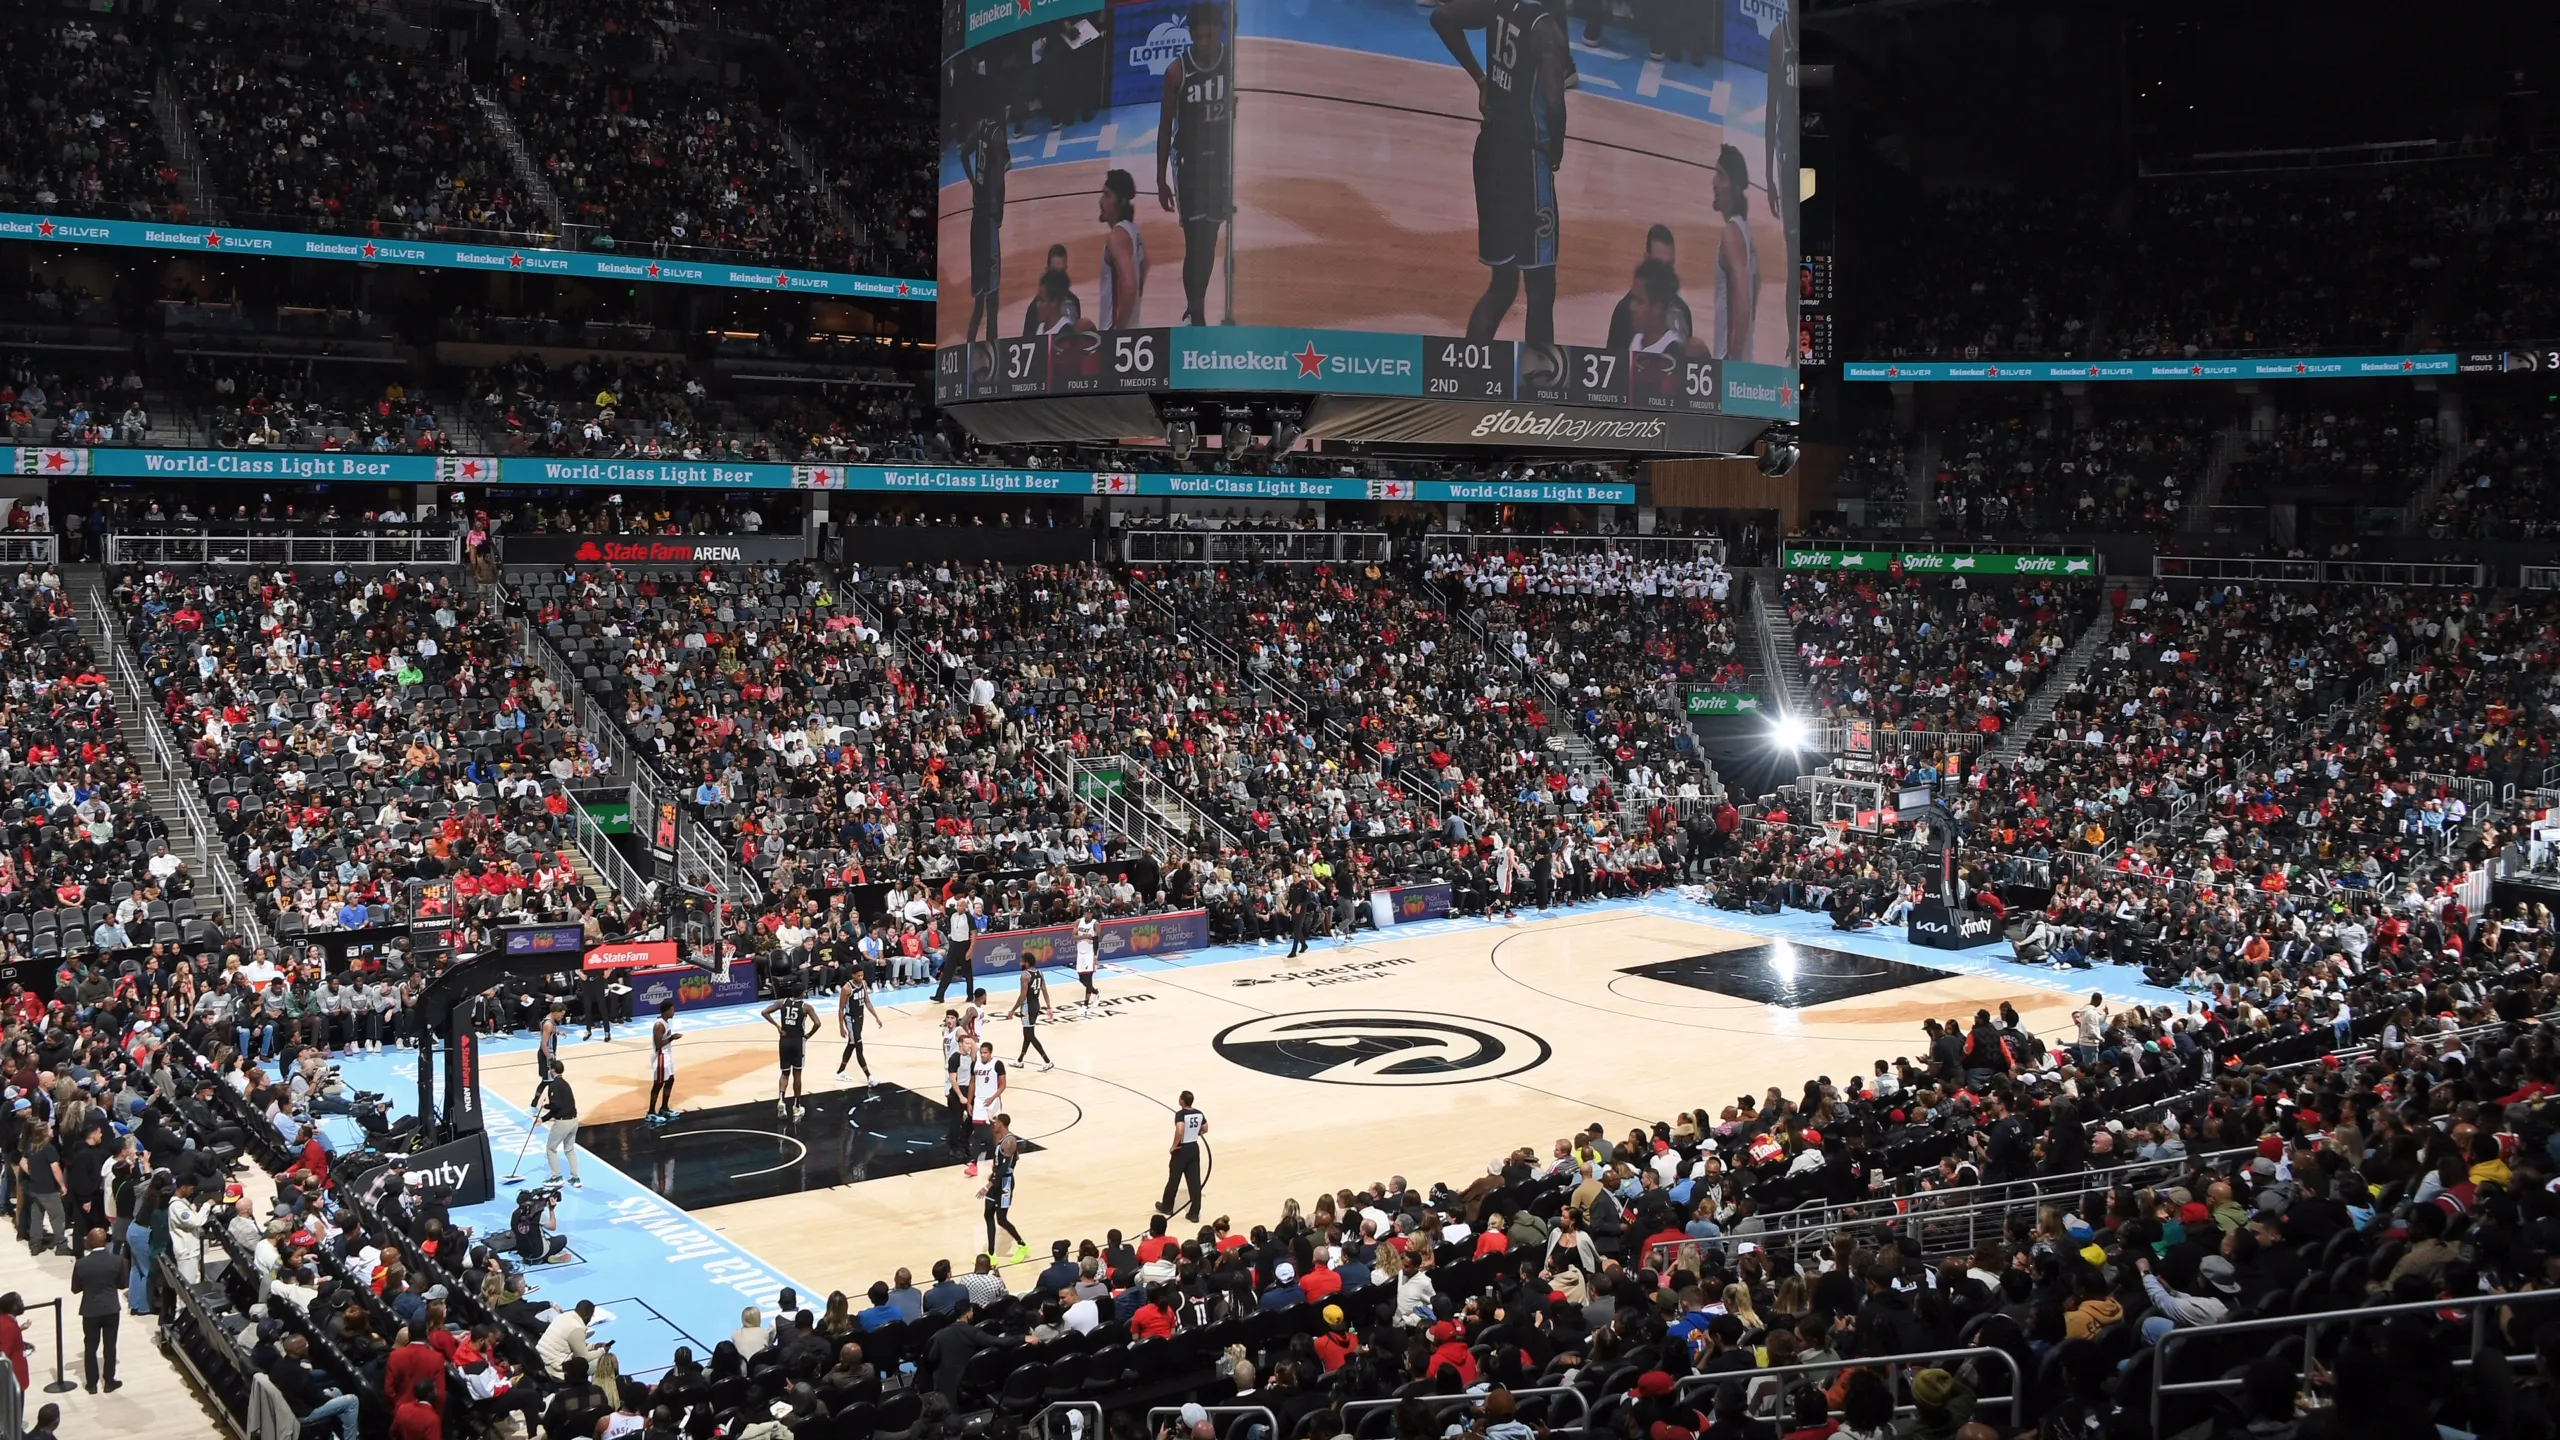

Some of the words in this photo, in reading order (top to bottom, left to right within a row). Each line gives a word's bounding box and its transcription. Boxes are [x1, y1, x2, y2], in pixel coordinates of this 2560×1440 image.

[969, 3, 1012, 31] Heineken
[1743, 0, 1785, 22] LOTTE
[1492, 14, 1520, 70] 15
[1133, 44, 1192, 63] LOTTE
[1187, 75, 1225, 103] atl
[1204, 103, 1226, 122] 12
[58, 226, 110, 239] SILVER
[145, 231, 200, 244] Heineken
[225, 237, 273, 249] SILVER
[306, 242, 357, 255] Heineken
[380, 248, 425, 260] SILVER
[456, 252, 505, 265] Heineken
[526, 258, 568, 269] SILVER
[597, 262, 643, 275] Heineken
[663, 268, 702, 279] SILVER
[729, 272, 772, 284] Heineken
[791, 278, 828, 288] SILVER
[854, 282, 894, 293] Heineken
[911, 287, 937, 297] SILVE
[1008, 343, 1036, 378] 37
[1114, 335, 1154, 373] 56
[1441, 343, 1492, 370] 4:01
[941, 351, 959, 375] 4:01
[1182, 350, 1288, 371] Heineken
[1330, 356, 1411, 376] SILVER
[1582, 354, 1616, 389] 37
[2050, 367, 2086, 376] Heineken
[2152, 366, 2188, 375] Heineken
[2256, 365, 2292, 374] Heineken
[2361, 363, 2399, 372] Heineken
[2415, 361, 2449, 369] SILVER
[1686, 363, 1713, 397] 56
[1850, 368, 1885, 376] Heineken
[1950, 368, 1984, 376] Heineken
[955, 384, 963, 397] 24
[1011, 383, 1038, 393] TIMEOUTS
[1041, 382, 1046, 391] 3
[1068, 380, 1089, 389] FOULS
[1093, 379, 1098, 388] 2
[1120, 378, 1157, 387] TIMEOUTS
[1163, 377, 1169, 386] 6
[1430, 379, 1458, 394] 2ND
[1486, 381, 1503, 396] 24
[1537, 391, 1559, 400] FOULS
[1588, 393, 1618, 404] TIMEOUTS
[1623, 395, 1627, 404] 3
[1729, 380, 1776, 402] Heineken
[1648, 398, 1667, 407] FOULS
[1669, 398, 1674, 407] 2
[1689, 401, 1715, 411] TIMEOUTS
[145, 454, 273, 474] World-Class
[281, 458, 335, 477] Light
[342, 459, 390, 476] Beer
[545, 463, 654, 481] World-Class
[660, 466, 707, 485] Light
[713, 467, 753, 483] Beer
[884, 471, 976, 487] World-Class
[981, 473, 1020, 490] Light
[1024, 474, 1059, 489] Beer
[1170, 478, 1255, 494] World-Class
[1260, 479, 1296, 496] Light
[1300, 481, 1332, 495] Beer
[1449, 483, 1539, 501] World-Class
[1544, 486, 1582, 502] Light
[1586, 487, 1622, 501] Beer
[693, 546, 741, 561] ARENA
[1791, 551, 1832, 568] Sprite
[1904, 554, 1943, 570] Sprite
[2014, 556, 2057, 573] Sprite
[1689, 696, 1728, 713] Sprite
[424, 919, 451, 928] TISSOT
[1131, 924, 1157, 937] CASH
[1960, 917, 1992, 939] xfinity
[1023, 937, 1051, 948] CASH
[1100, 940, 1124, 949] OTTERY
[1130, 933, 1160, 952] POP
[986, 953, 1016, 963] LOTTERY
[679, 976, 709, 988] CASH
[1031, 978, 1042, 990] 41
[1307, 971, 1396, 988] ARENA
[641, 991, 672, 1000] LOTTERY
[677, 984, 712, 1004] POP
[784, 1006, 799, 1020] 15
[463, 1087, 472, 1113] ARENA
[1189, 1116, 1198, 1128] 55
[417, 1160, 470, 1190] nity
[608, 1196, 729, 1263] hawks
